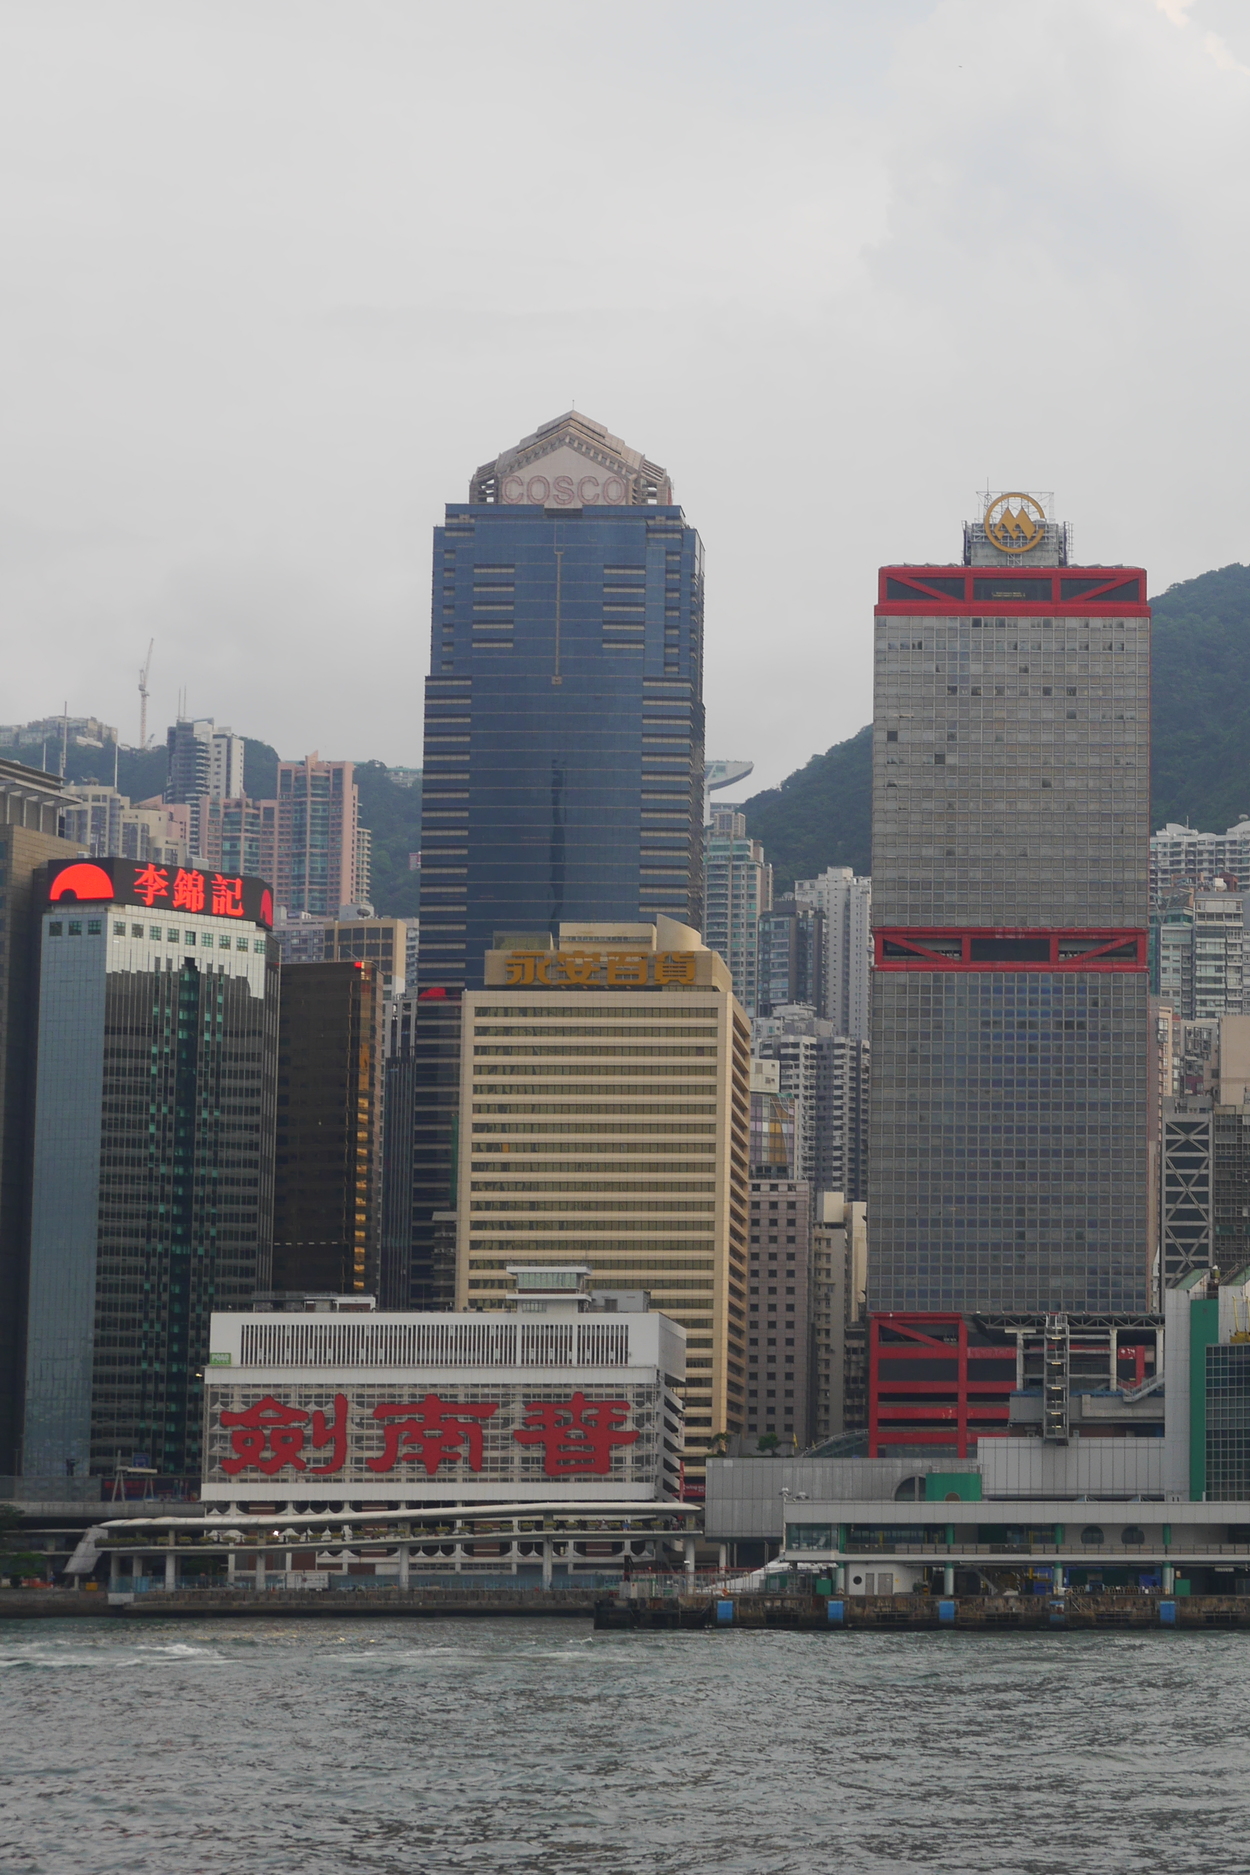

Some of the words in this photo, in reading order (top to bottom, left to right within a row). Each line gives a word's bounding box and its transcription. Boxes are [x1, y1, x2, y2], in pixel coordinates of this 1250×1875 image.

[501, 475, 627, 506] COSCO
[133, 862, 244, 917] 李錦記
[505, 950, 695, 986] 永安百貨
